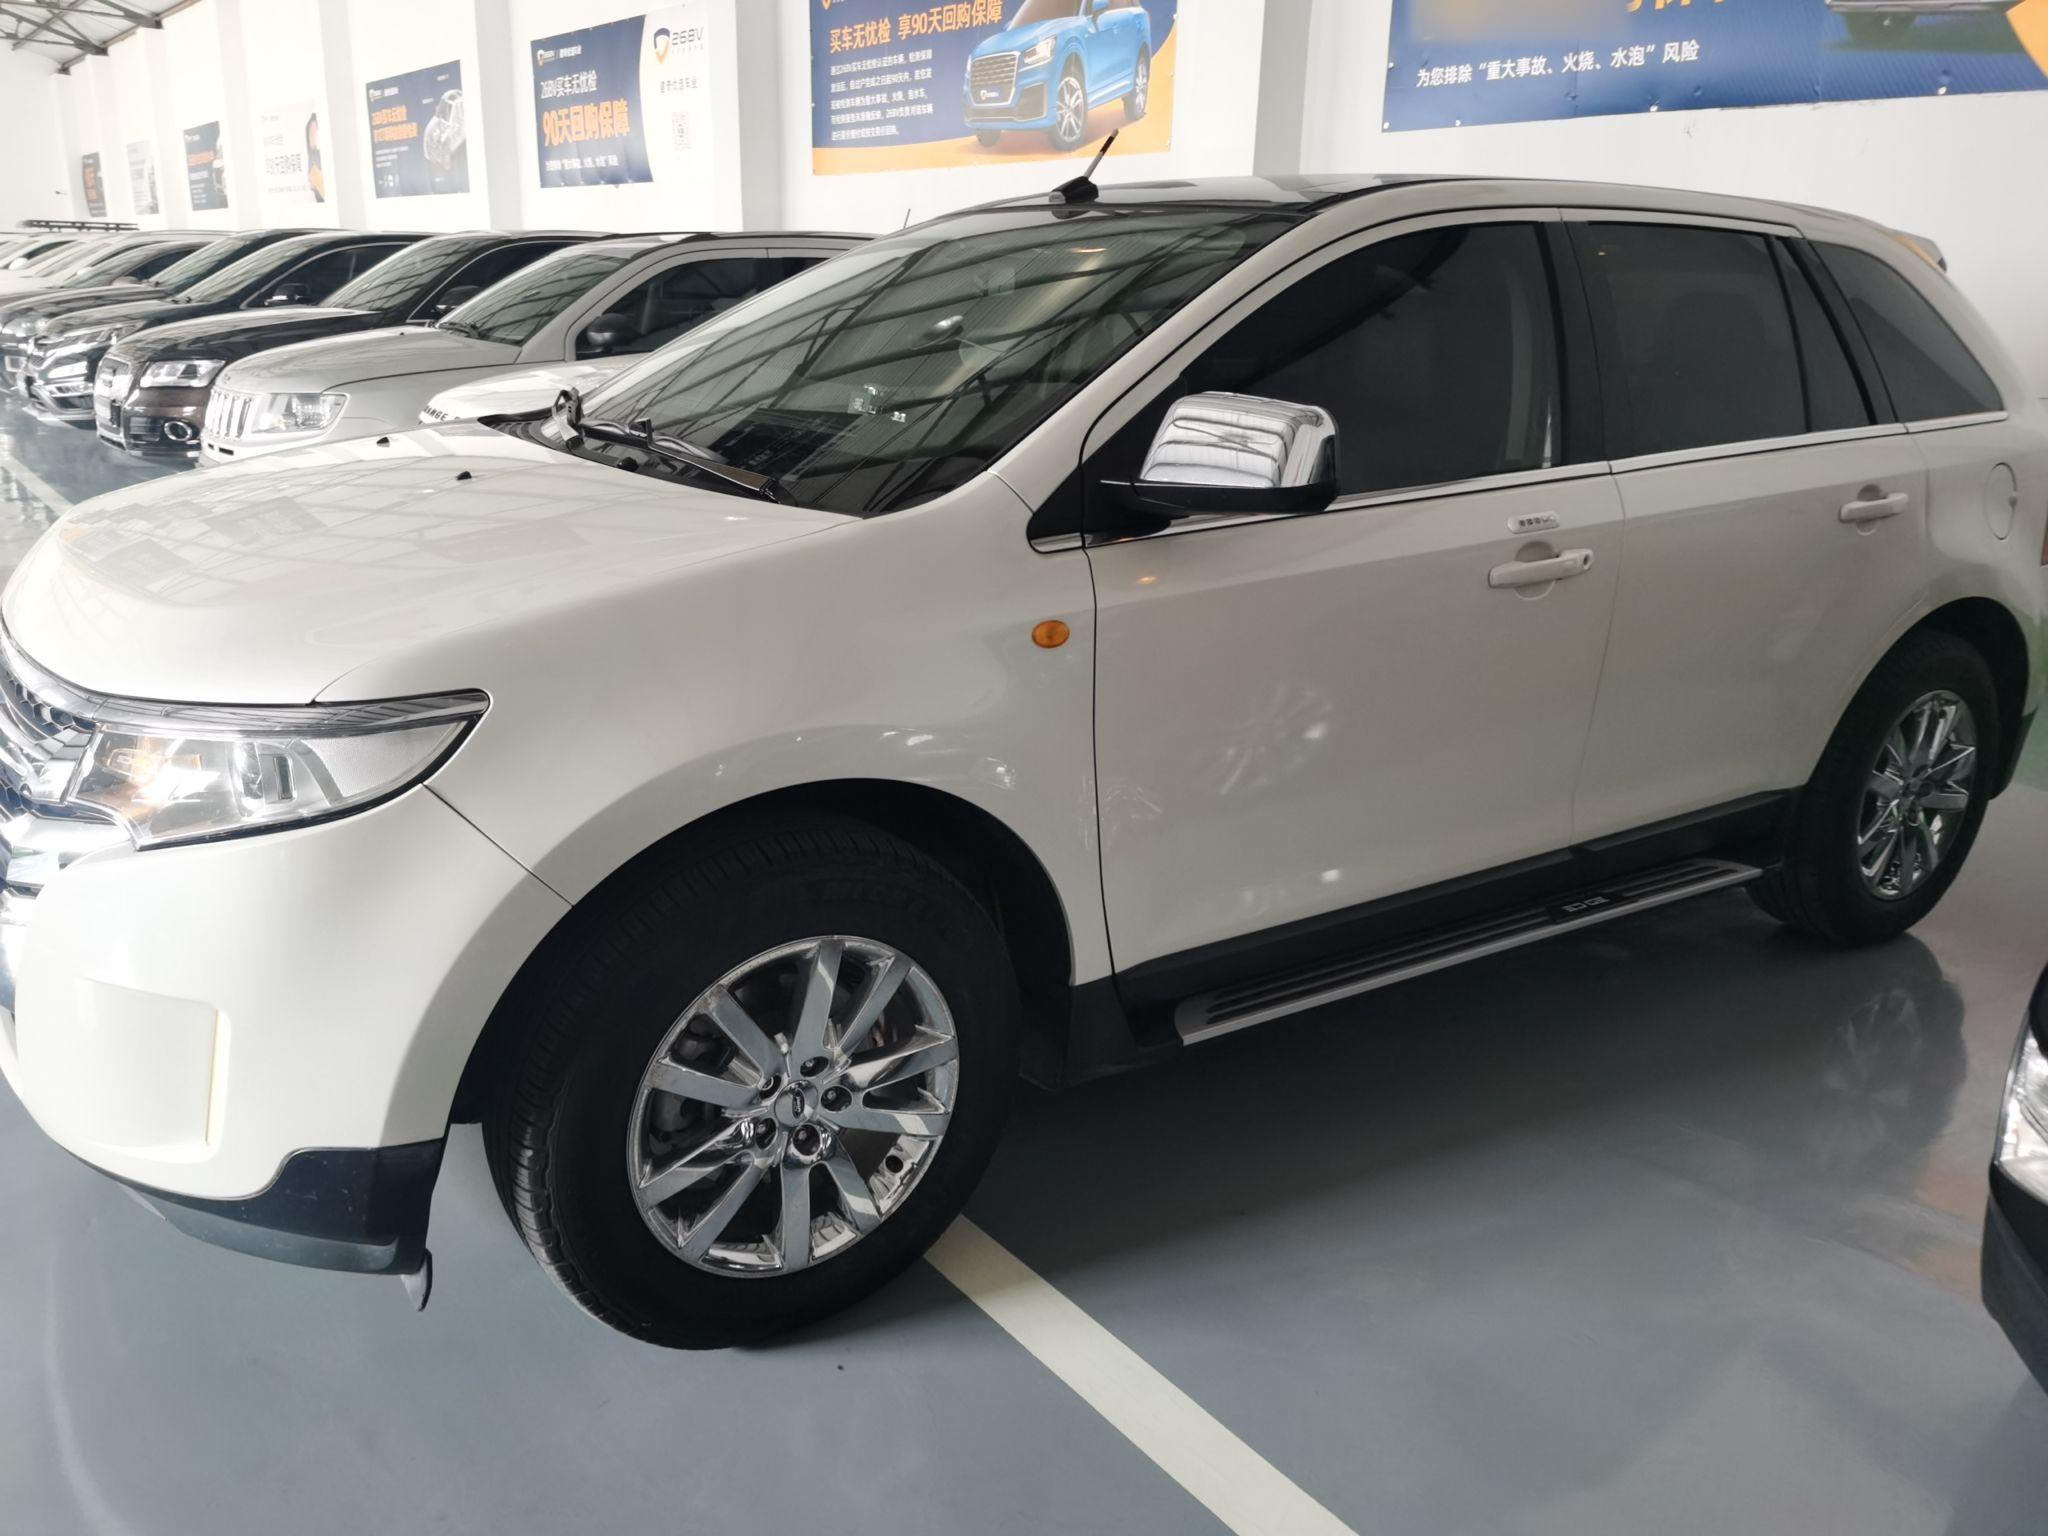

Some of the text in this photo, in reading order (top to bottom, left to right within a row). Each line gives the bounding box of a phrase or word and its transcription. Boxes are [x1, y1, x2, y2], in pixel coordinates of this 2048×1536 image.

[830, 0, 1003, 54] 买车无忧检 享90天回购保障
[542, 98, 630, 147] 90天回购保障
